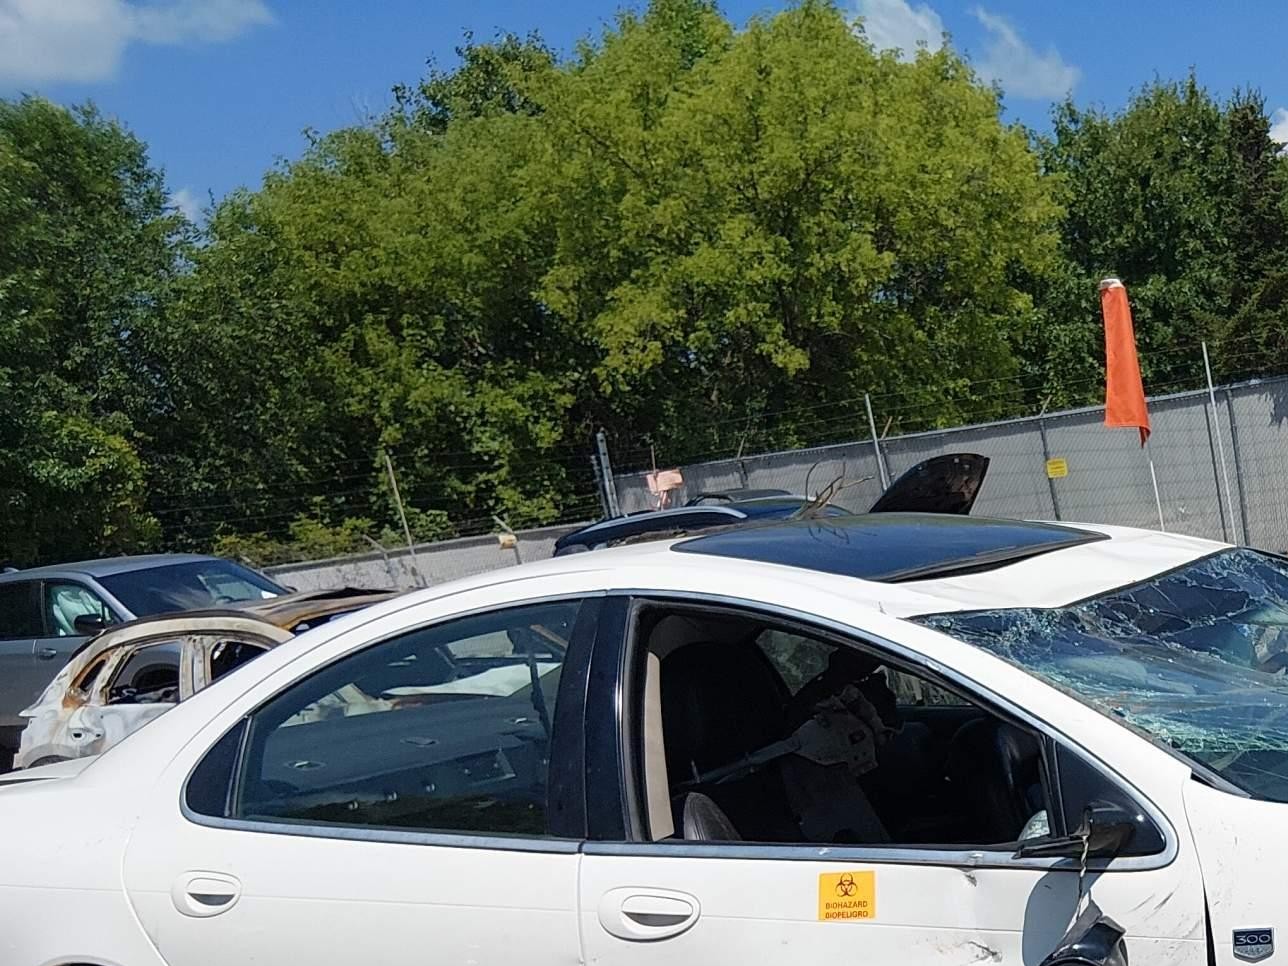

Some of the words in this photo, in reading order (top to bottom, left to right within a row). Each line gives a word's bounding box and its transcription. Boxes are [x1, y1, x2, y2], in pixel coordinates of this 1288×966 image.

[825, 900, 868, 909] BIOHAZARD
[825, 910, 869, 919] BIOPELIGRO
[1235, 934, 1271, 945] 300
